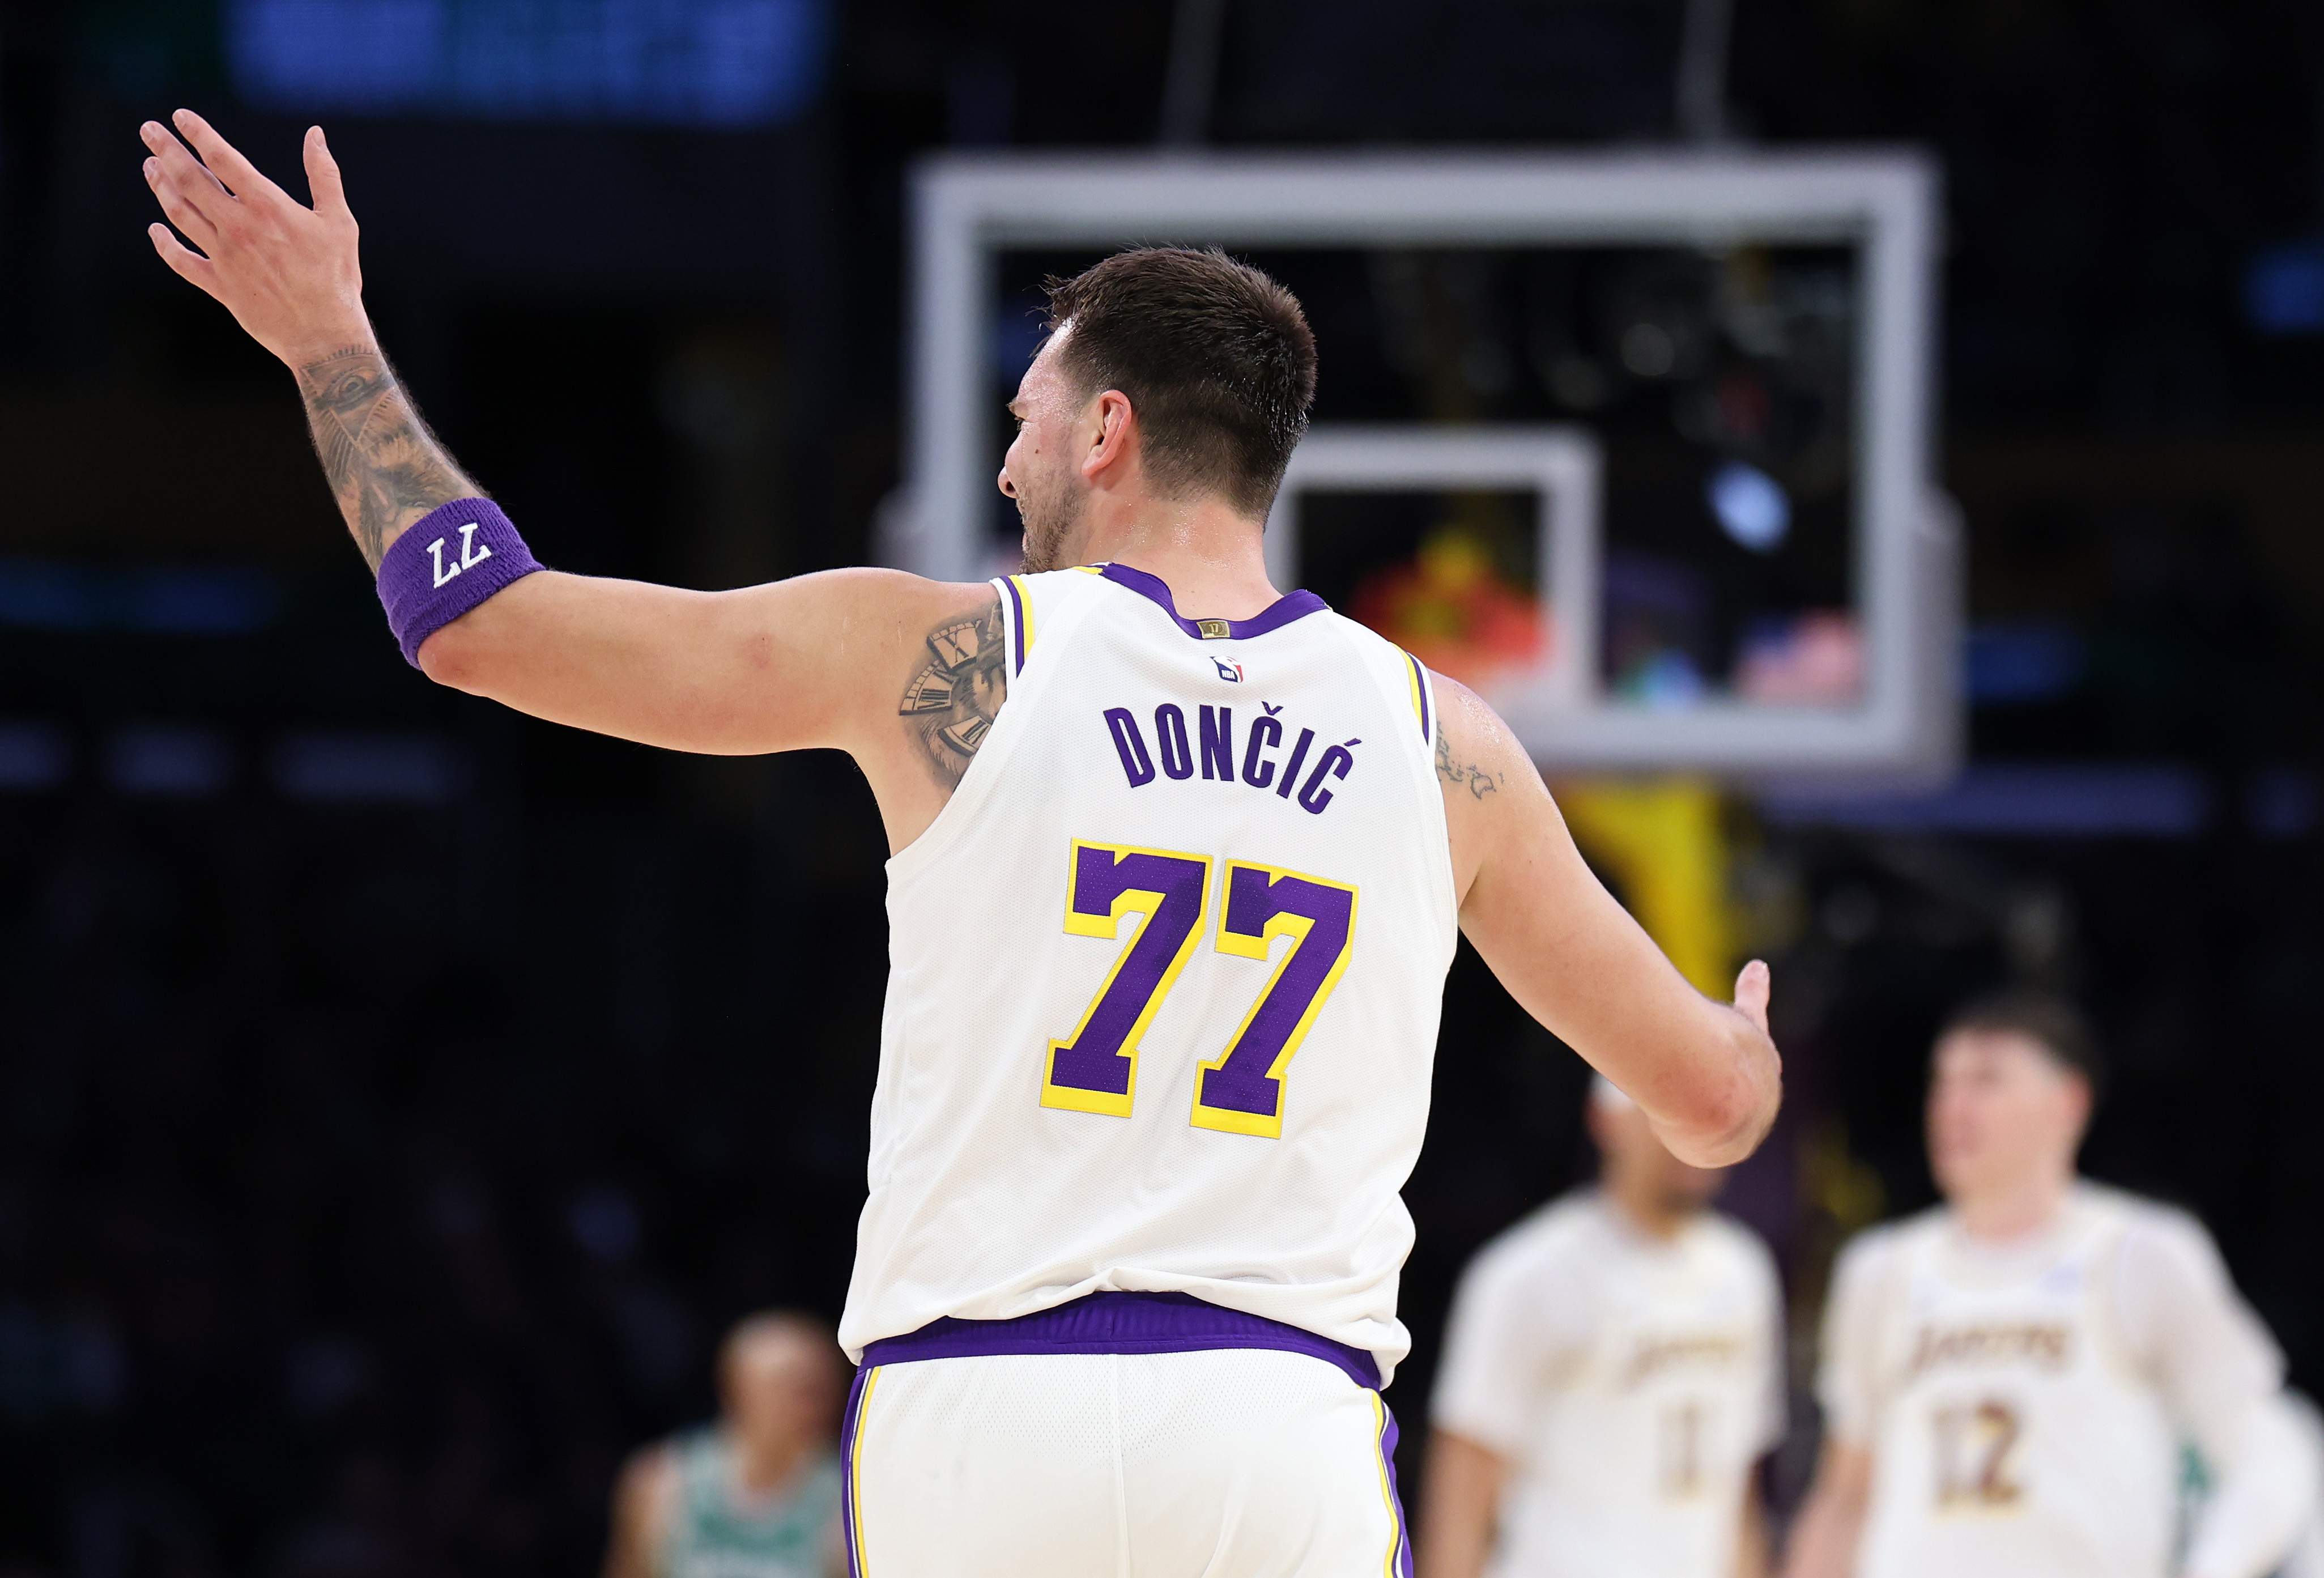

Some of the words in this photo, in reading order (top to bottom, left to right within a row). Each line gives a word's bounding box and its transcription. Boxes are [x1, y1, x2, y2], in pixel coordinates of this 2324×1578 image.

[1221, 669, 1235, 679] NBA
[1103, 701, 1362, 815] DONČIĆ
[1039, 837, 1360, 1140] 77
